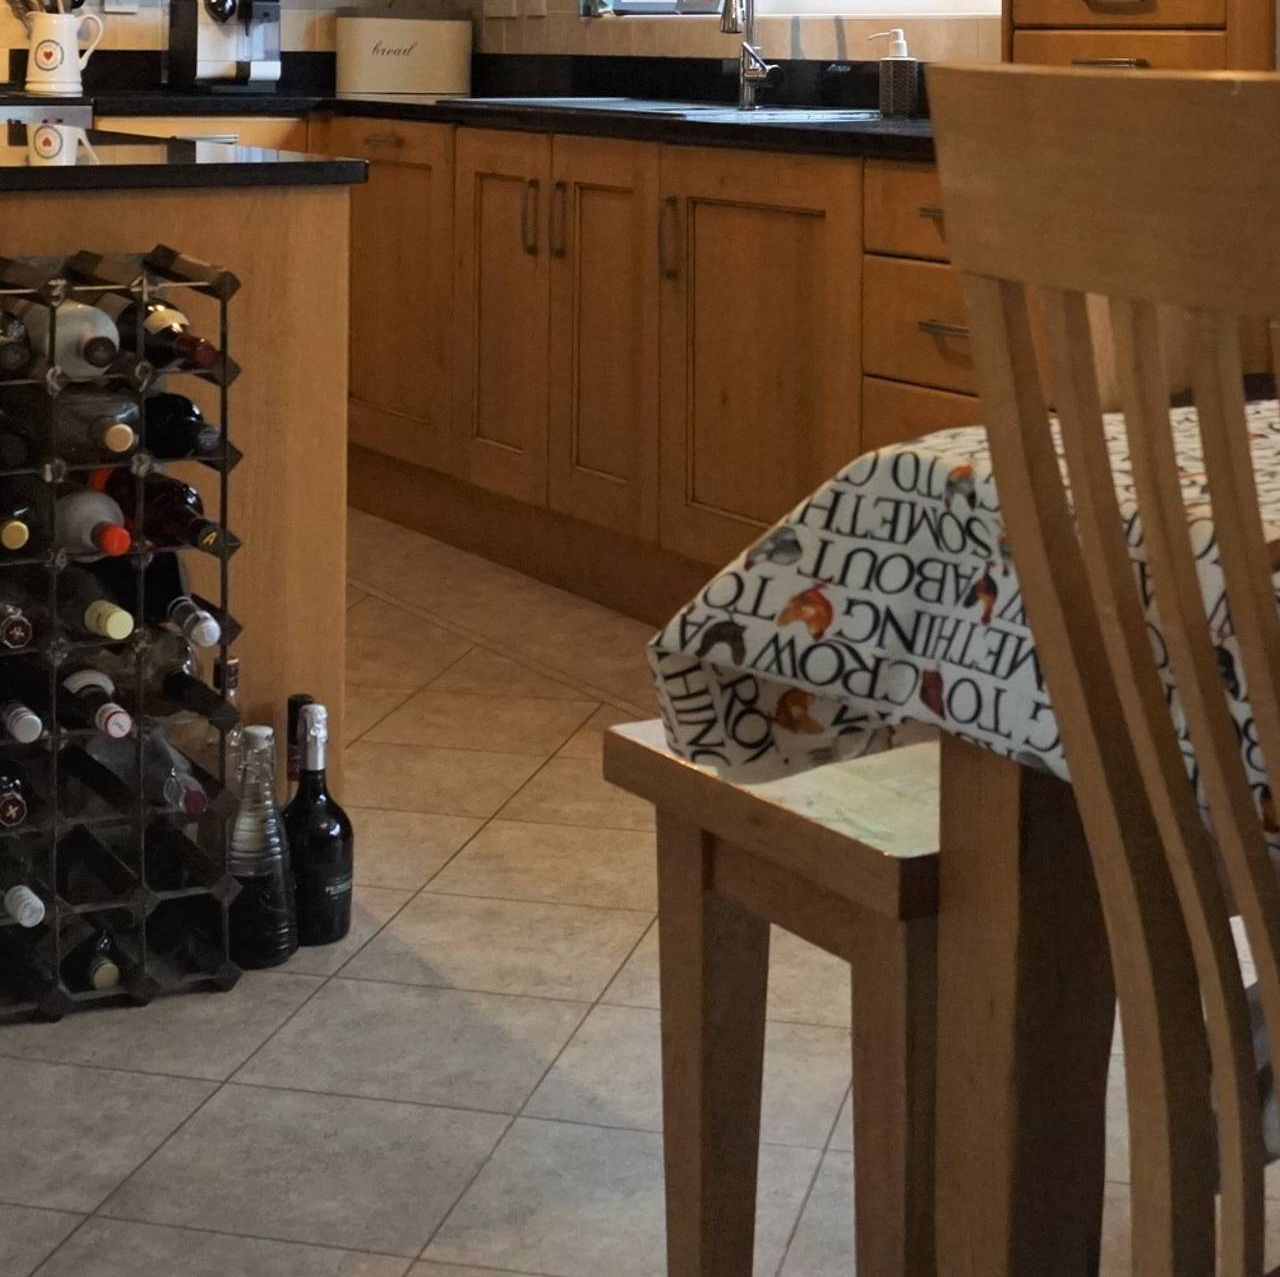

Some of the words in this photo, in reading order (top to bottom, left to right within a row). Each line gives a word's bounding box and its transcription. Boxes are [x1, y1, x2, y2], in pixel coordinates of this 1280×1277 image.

[371, 40, 419, 56] bread
[797, 539, 979, 606] ABOUT
[751, 631, 919, 708] CROW
